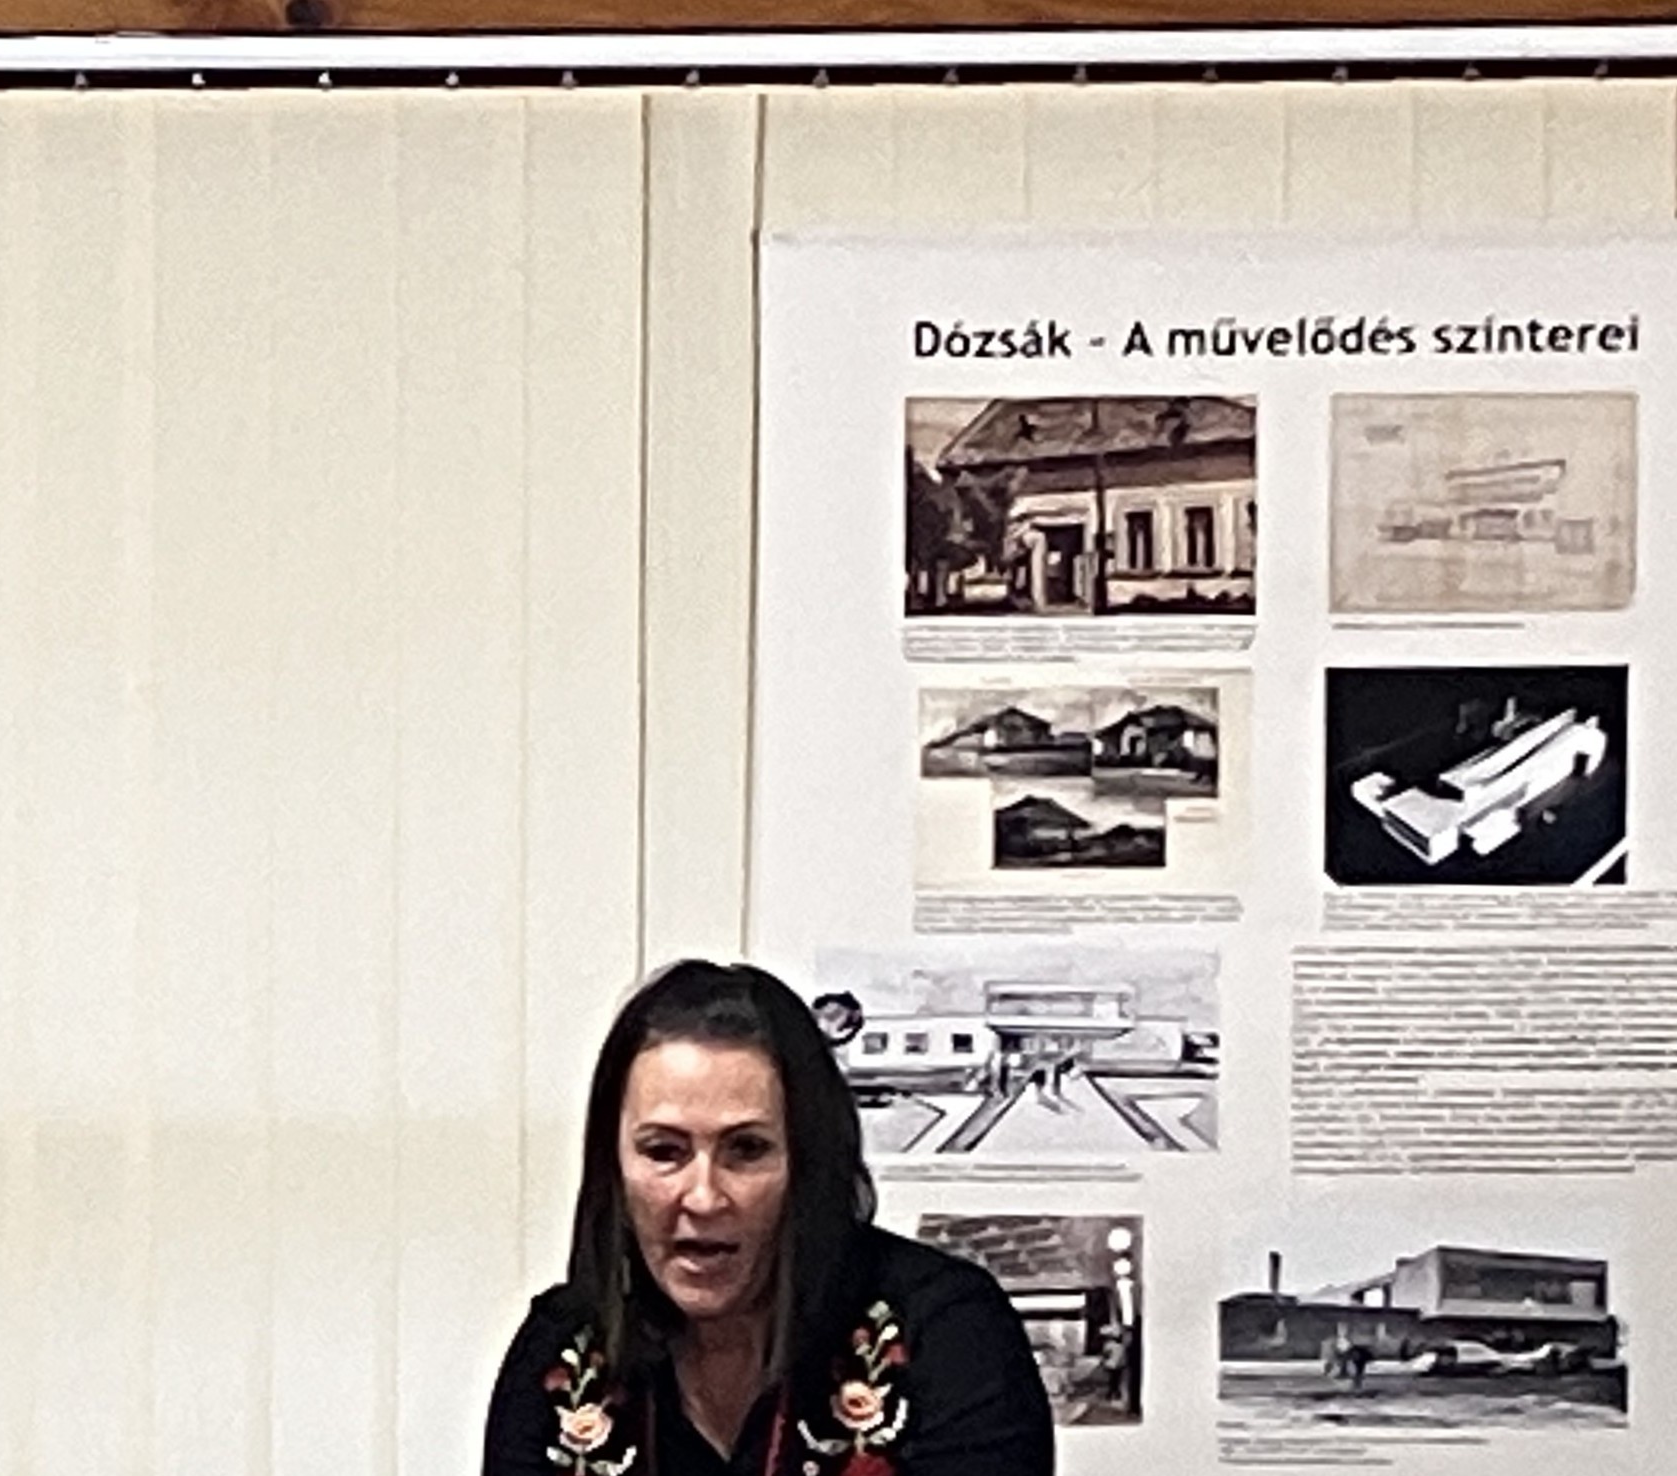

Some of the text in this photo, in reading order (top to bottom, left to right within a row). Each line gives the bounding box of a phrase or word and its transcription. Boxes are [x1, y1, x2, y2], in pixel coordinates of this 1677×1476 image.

[913, 320, 1072, 358] Dózsák
[1122, 321, 1153, 357] A
[1167, 315, 1417, 357] művelődés
